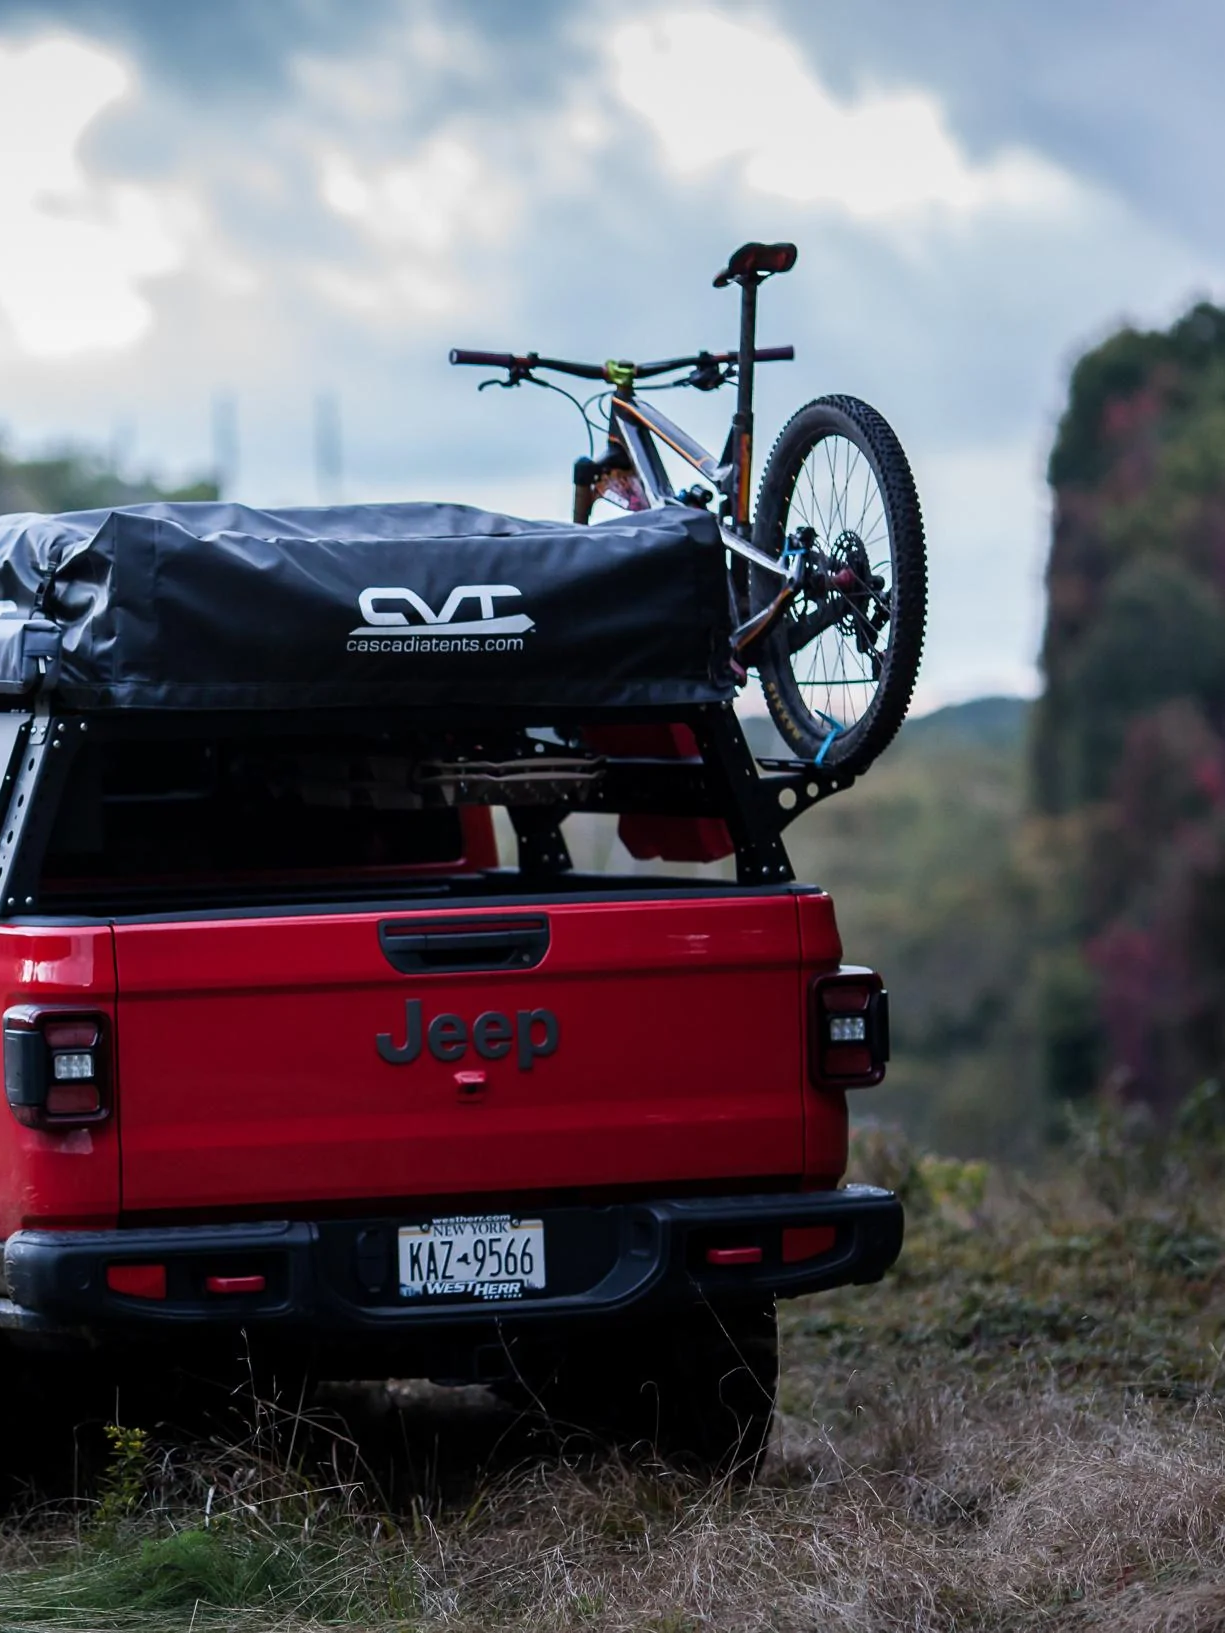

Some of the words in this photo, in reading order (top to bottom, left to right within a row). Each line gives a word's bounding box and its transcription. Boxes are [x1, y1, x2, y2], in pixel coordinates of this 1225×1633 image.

[347, 636, 524, 652] cascadiatents.com
[376, 998, 560, 1071] Jeep
[433, 1224, 466, 1238] NEW
[470, 1221, 509, 1235] YORK
[409, 1240, 454, 1282] KAZ
[473, 1237, 534, 1278] 9566
